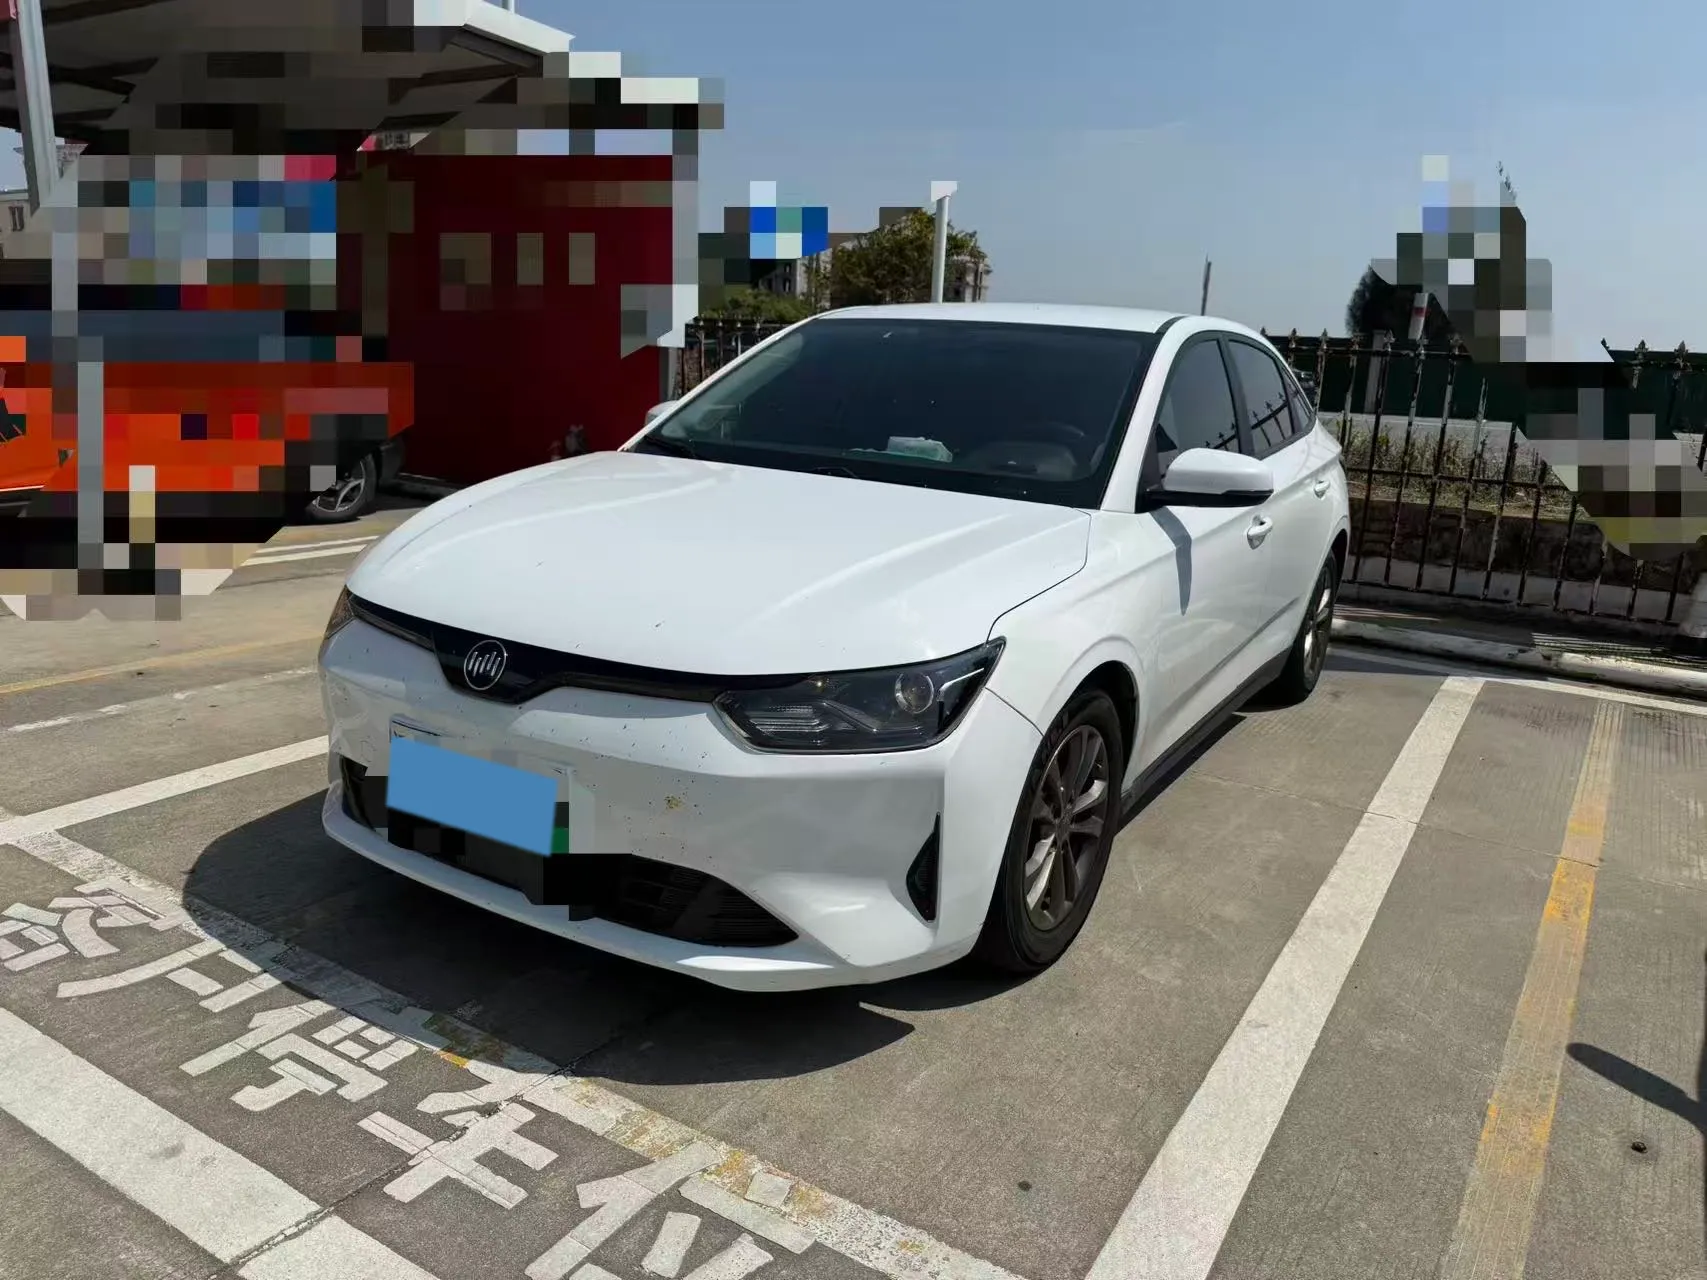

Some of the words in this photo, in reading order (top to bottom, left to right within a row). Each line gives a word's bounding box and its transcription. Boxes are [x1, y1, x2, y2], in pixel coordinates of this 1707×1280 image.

[0, 876, 817, 1280] 客户停车位
